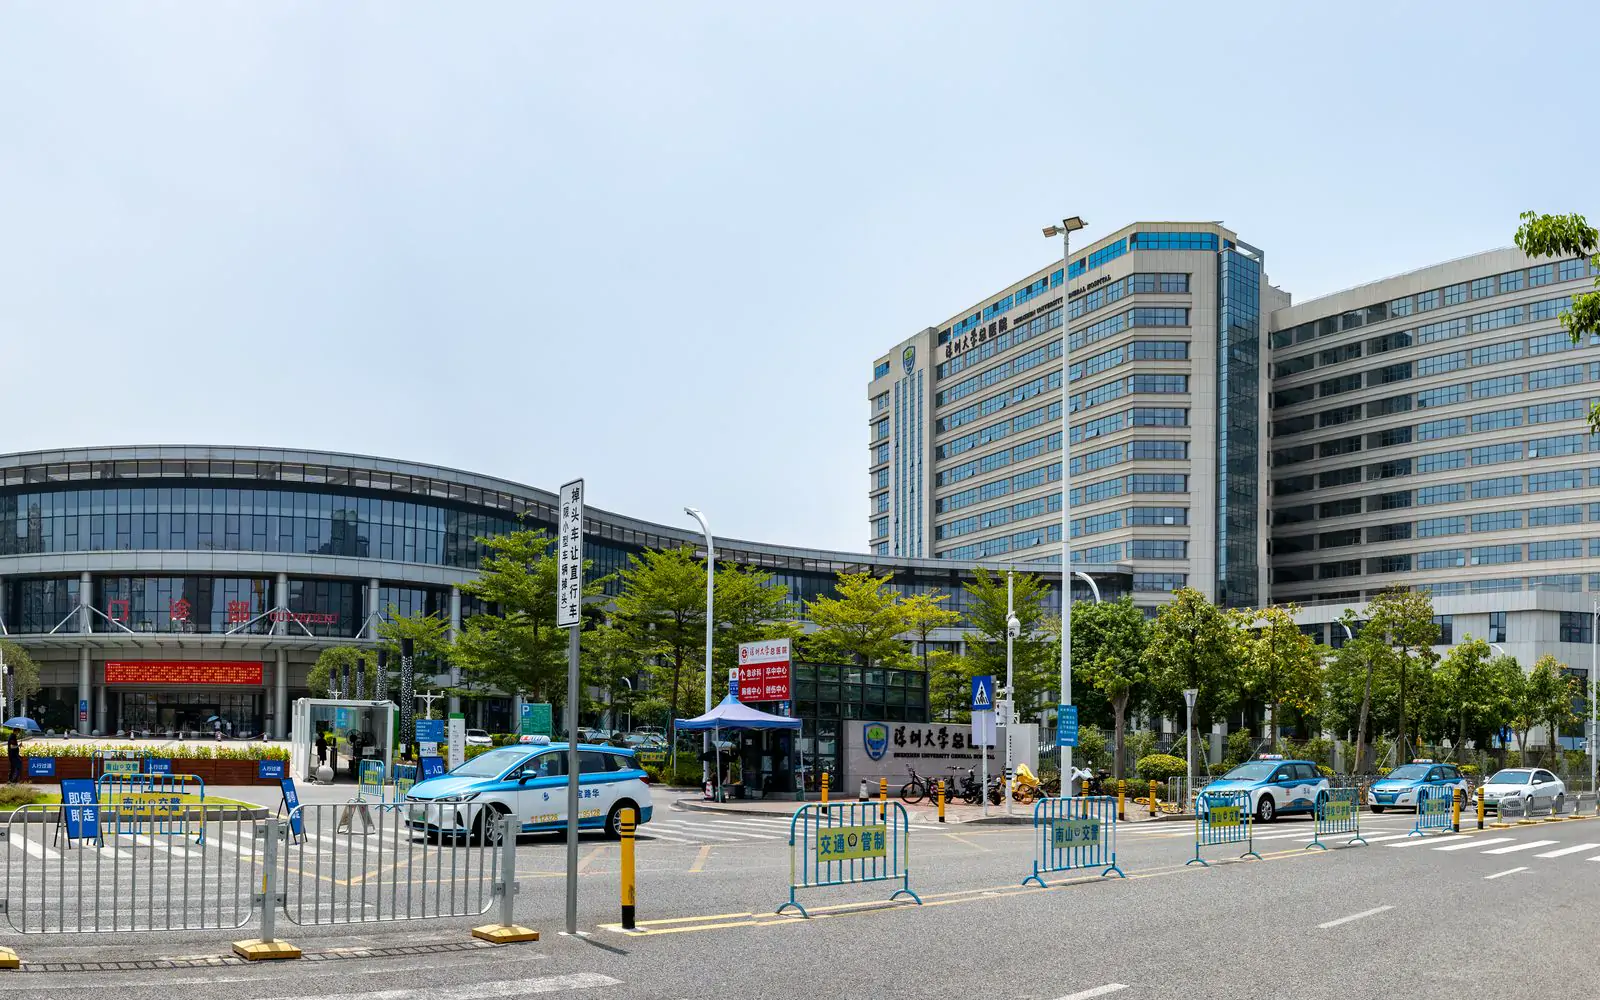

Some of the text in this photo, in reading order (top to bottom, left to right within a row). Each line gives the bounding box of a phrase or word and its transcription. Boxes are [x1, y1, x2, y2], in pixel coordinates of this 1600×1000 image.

[1087, 275, 1112, 290] HOSPITAL
[569, 487, 580, 618] 掉头车让直行车
[107, 598, 250, 623] 门诊部
[522, 705, 530, 716] P
[68, 791, 93, 806] 即停
